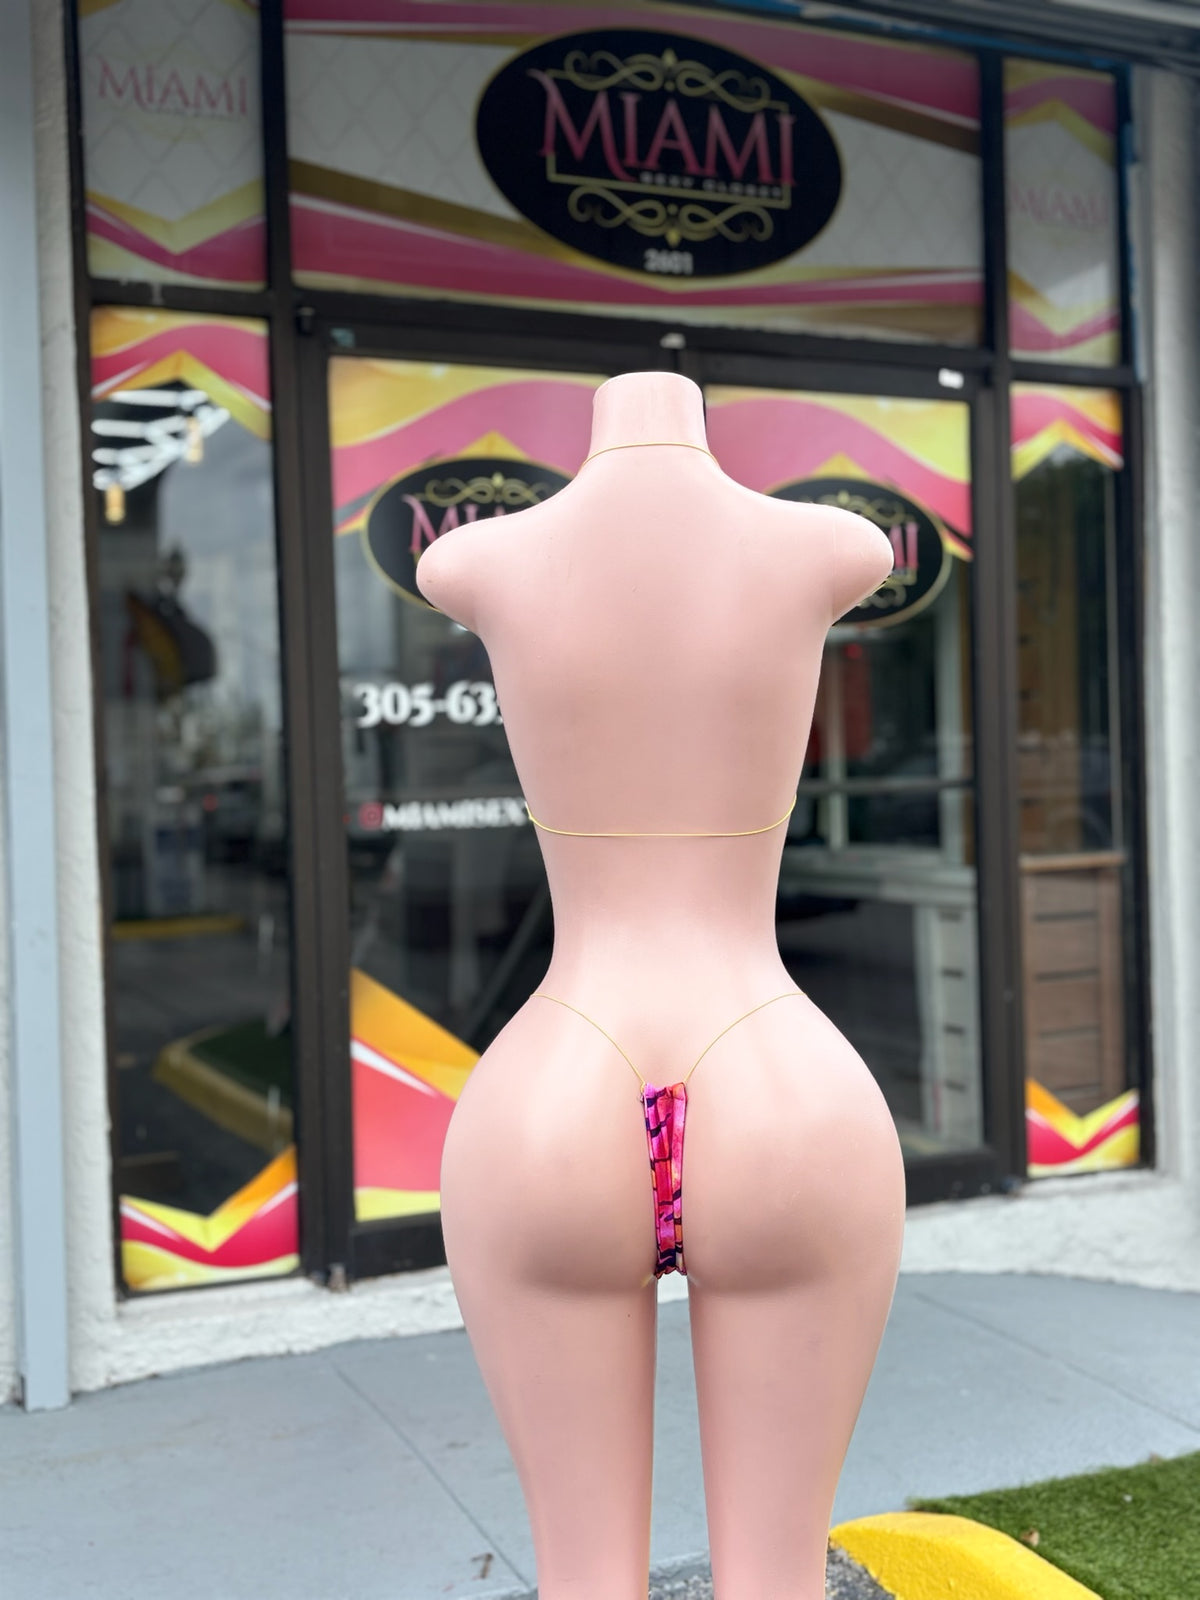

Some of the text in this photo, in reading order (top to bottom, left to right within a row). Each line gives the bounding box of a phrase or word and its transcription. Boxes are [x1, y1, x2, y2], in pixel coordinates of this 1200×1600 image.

[96, 54, 247, 117] MIAMI
[526, 68, 796, 187] MIAMI
[353, 680, 504, 729] 305-63
